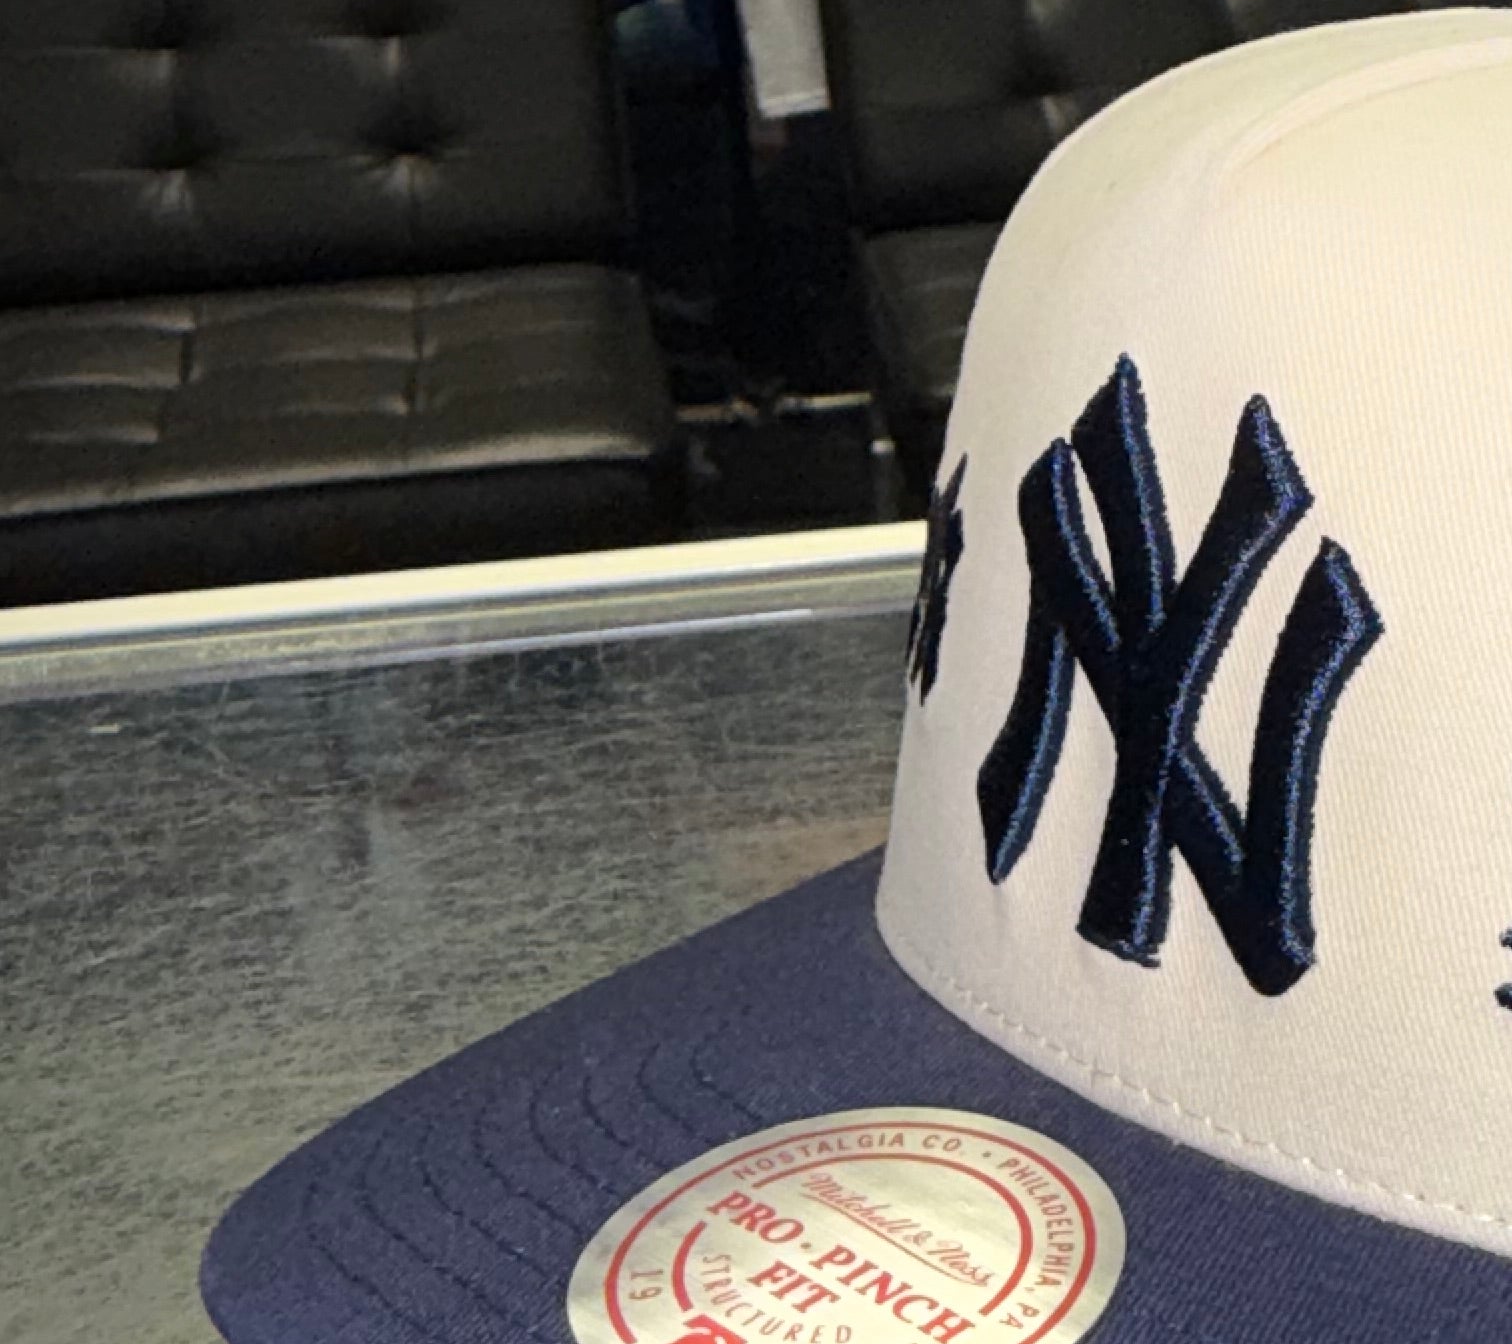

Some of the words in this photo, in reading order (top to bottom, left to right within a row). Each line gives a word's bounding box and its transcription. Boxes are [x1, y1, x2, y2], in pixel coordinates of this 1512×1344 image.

[976, 353, 1384, 997] NY
[707, 1191, 804, 1244] PRO
[731, 1132, 905, 1181] NOSTALGIA
[1000, 1303, 1040, 1329] PA
[800, 1171, 921, 1235] Mitchell
[701, 1254, 852, 1344] STRUCTURED
[746, 1260, 842, 1313] FIT
